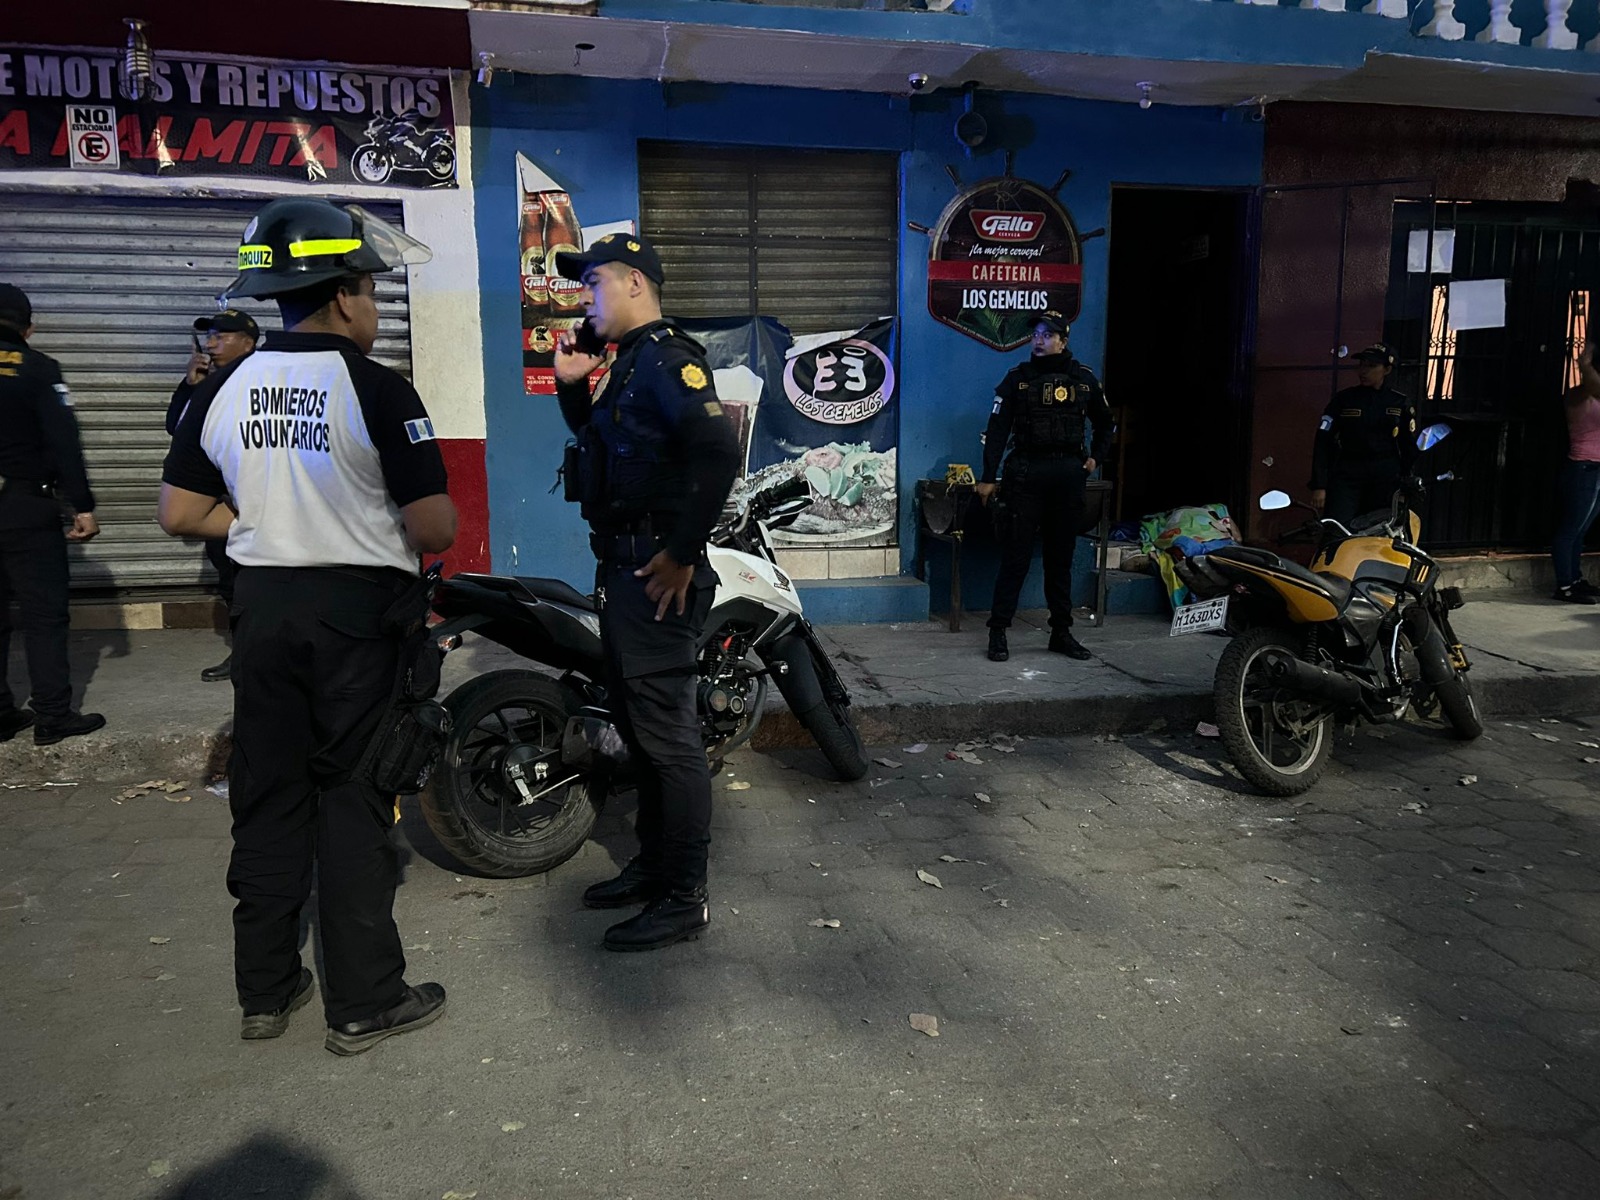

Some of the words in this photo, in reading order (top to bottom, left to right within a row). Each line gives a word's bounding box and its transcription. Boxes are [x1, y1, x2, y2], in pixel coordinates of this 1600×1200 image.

[181, 63, 207, 104] Y
[217, 65, 441, 118] REPUESTOS
[74, 108, 109, 124] NO
[51, 113, 338, 168] ALMITA
[981, 215, 1034, 236] Gallo
[984, 245, 1009, 258] mejor
[1009, 244, 1045, 260] cerveza!
[972, 264, 1041, 282] CAFETERIA
[962, 289, 987, 309] LOS
[989, 290, 1048, 311] GEMELOS
[795, 393, 824, 415] LOS
[823, 392, 883, 421] GEMELOS
